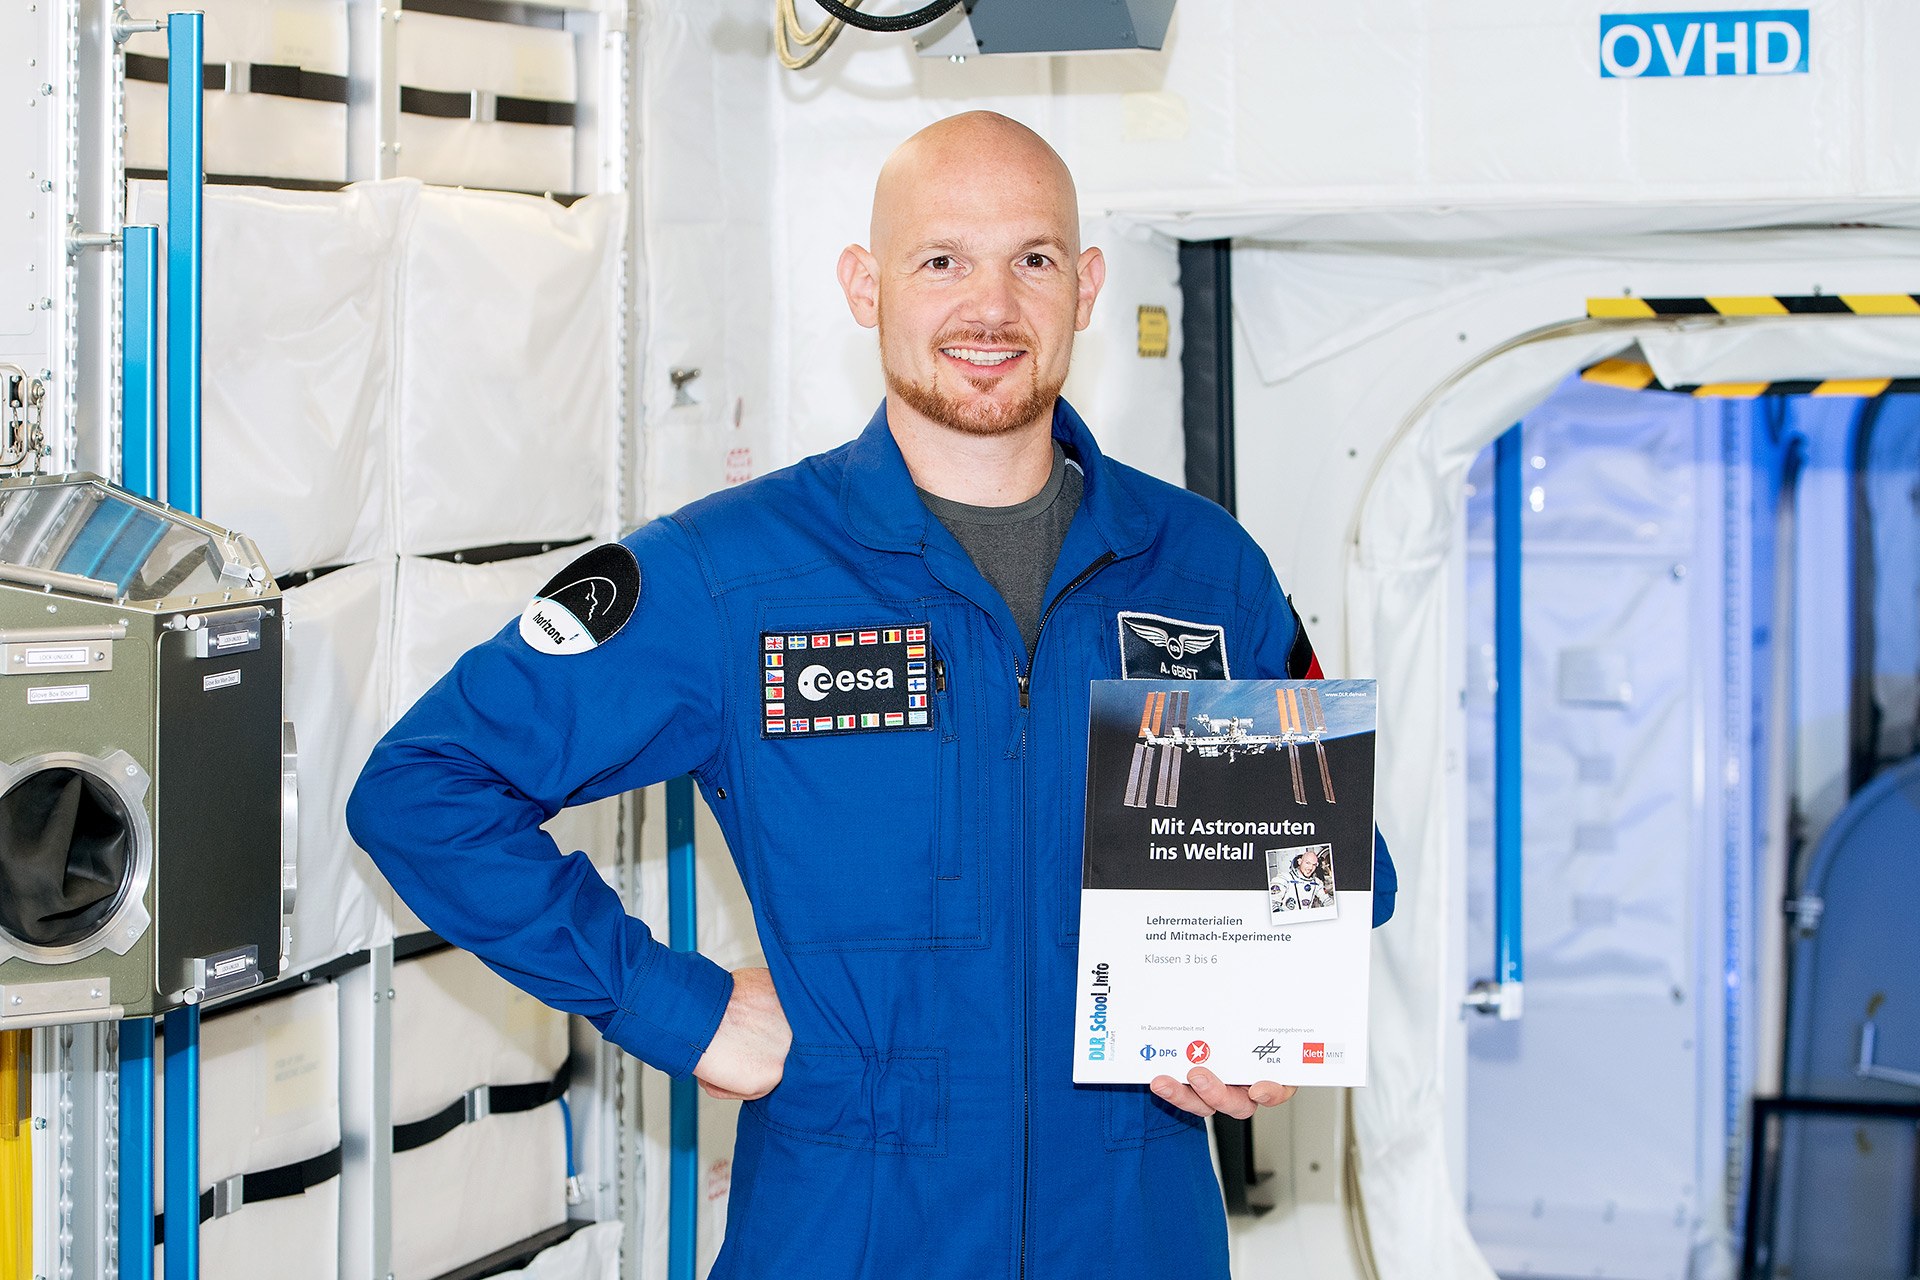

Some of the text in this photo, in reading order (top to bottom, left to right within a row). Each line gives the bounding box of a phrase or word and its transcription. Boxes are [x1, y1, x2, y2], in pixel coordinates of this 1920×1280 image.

[1601, 20, 1801, 78] OVHD
[532, 610, 565, 645] horizons
[1160, 662, 1198, 680] A. GERST
[1150, 818, 1315, 835] Mit Astronauten
[1149, 842, 1254, 860] ins Weltall
[1146, 916, 1243, 926] Lehrermaterialien
[1145, 931, 1292, 943] und Mitmach-Experimente
[1144, 954, 1218, 964] Klassen 3 bis 6
[1159, 1049, 1178, 1057] DPG
[1303, 1049, 1324, 1058] Klett
